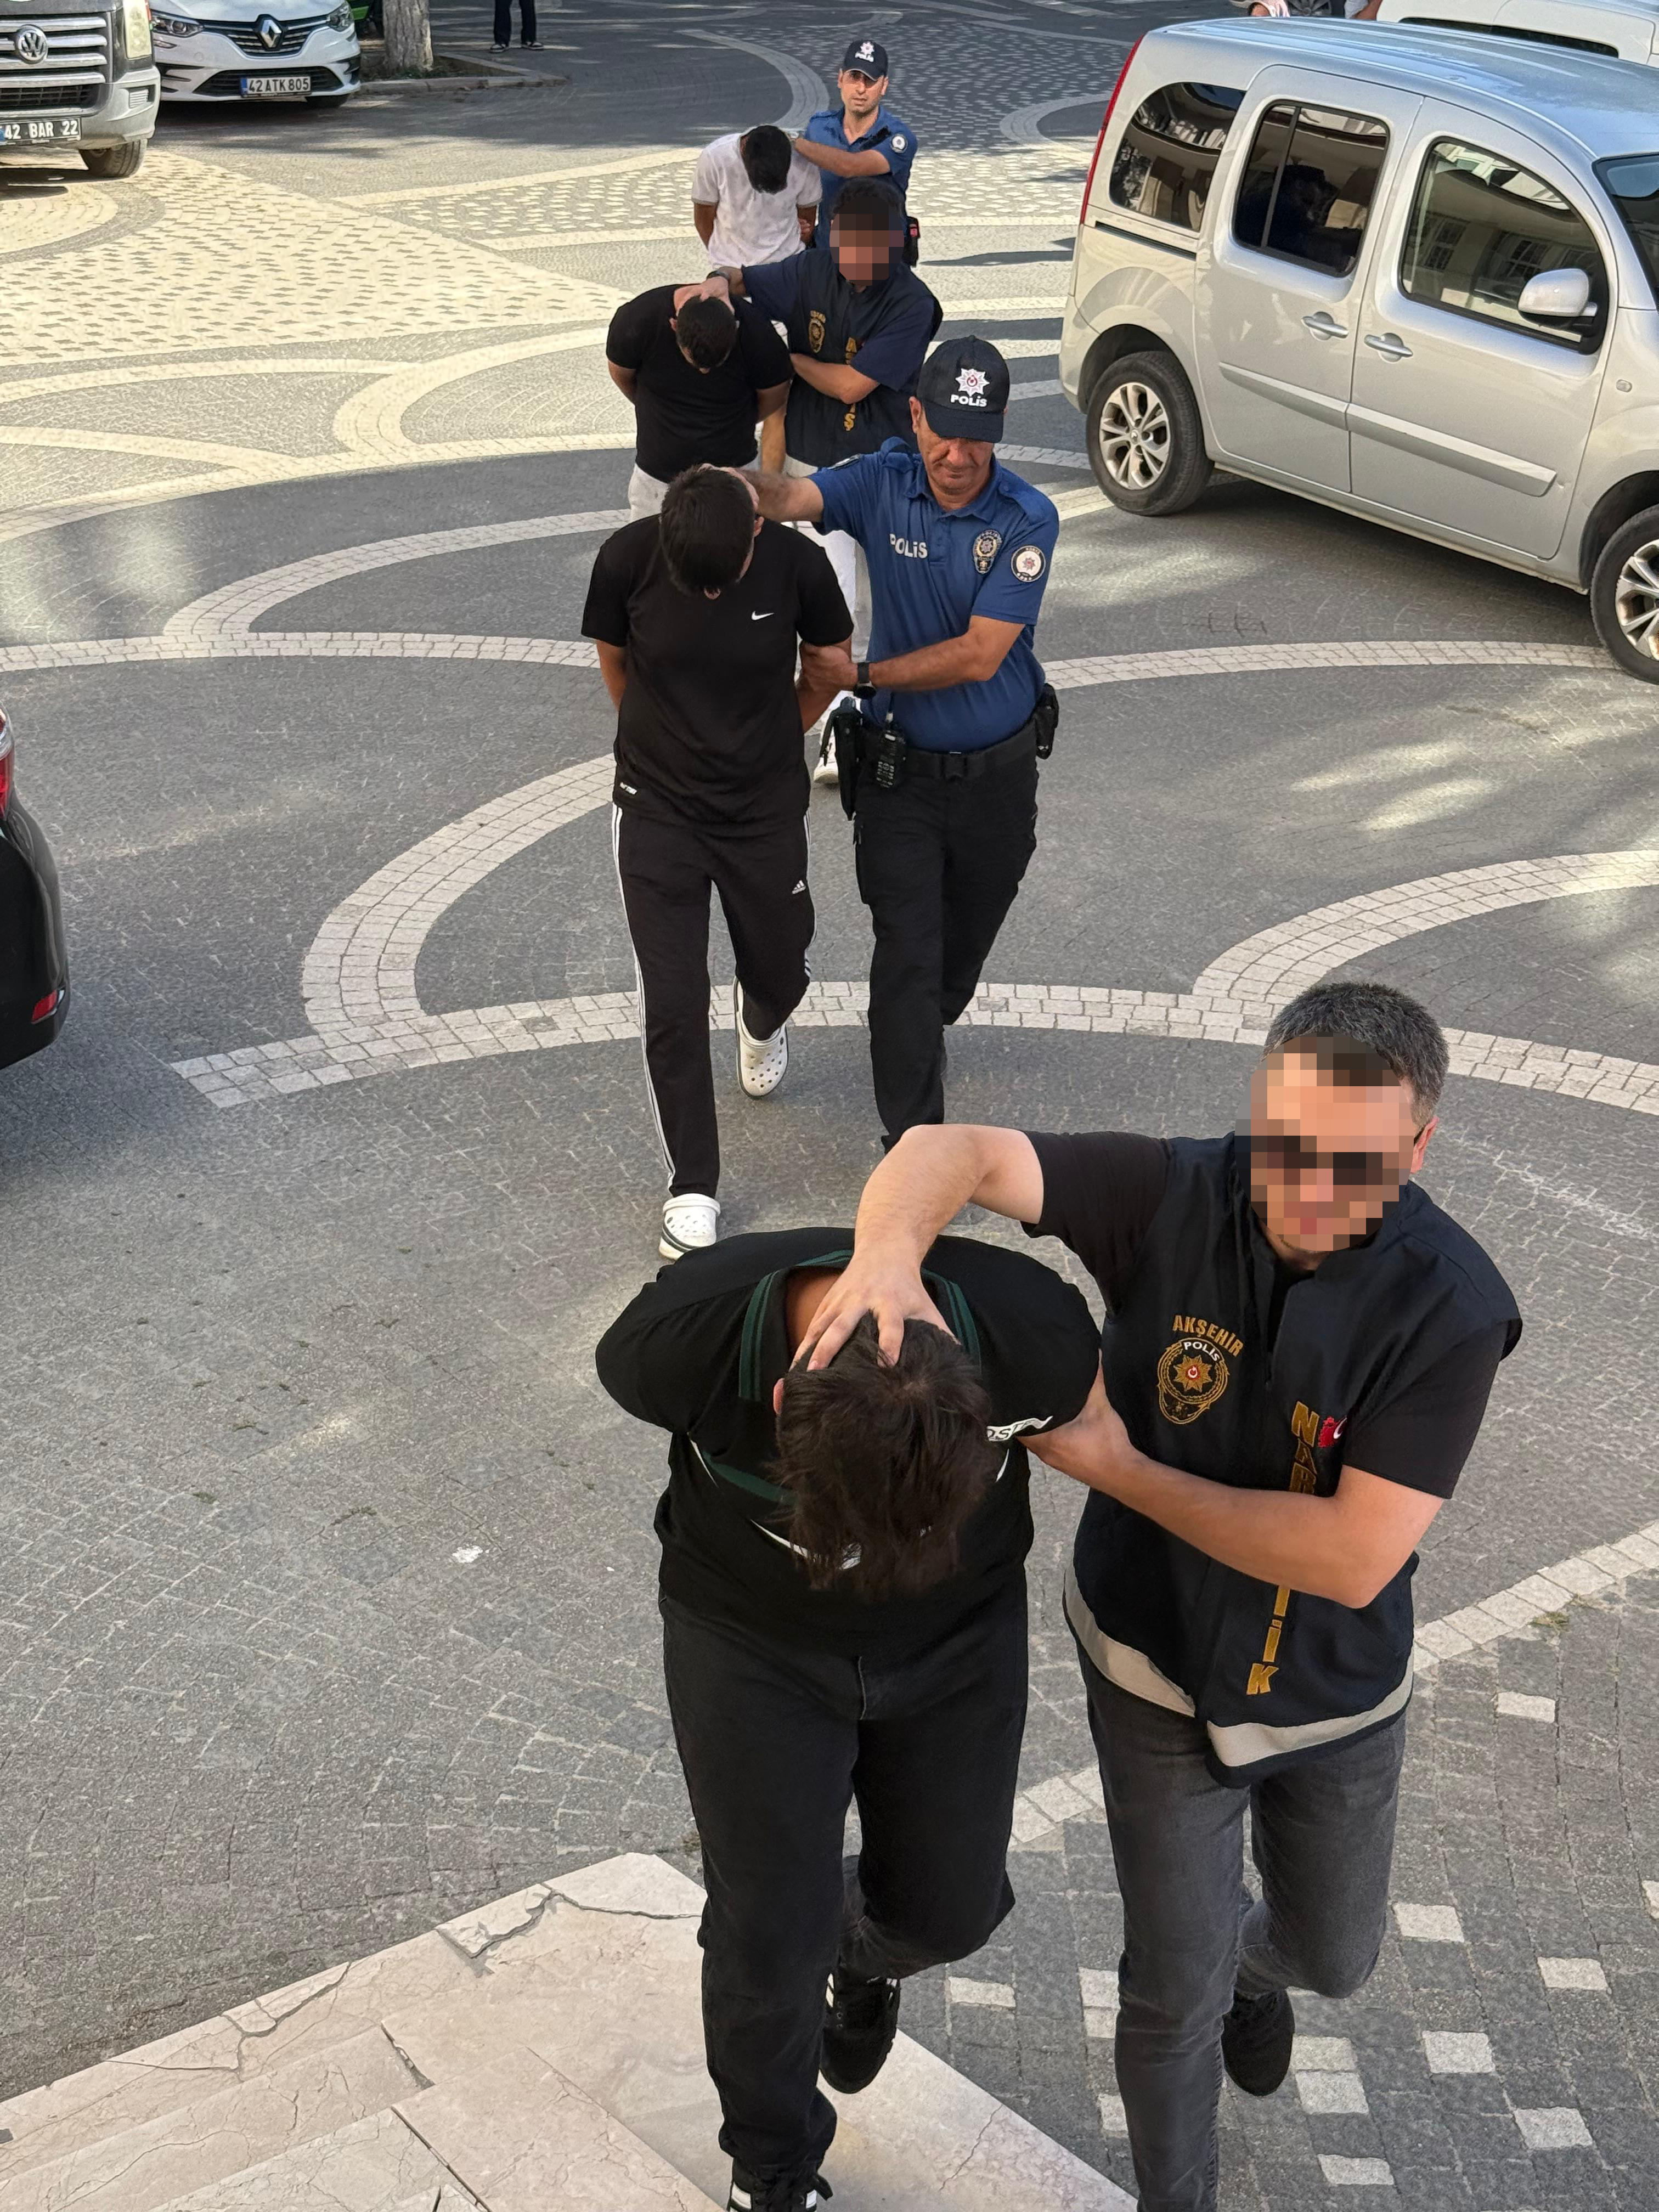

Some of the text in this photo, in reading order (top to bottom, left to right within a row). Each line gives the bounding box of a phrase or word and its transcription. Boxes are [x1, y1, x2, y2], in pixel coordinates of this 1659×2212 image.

[249, 78, 309, 92] 42 ATK 805
[4, 120, 78, 139] 42 BAR 22
